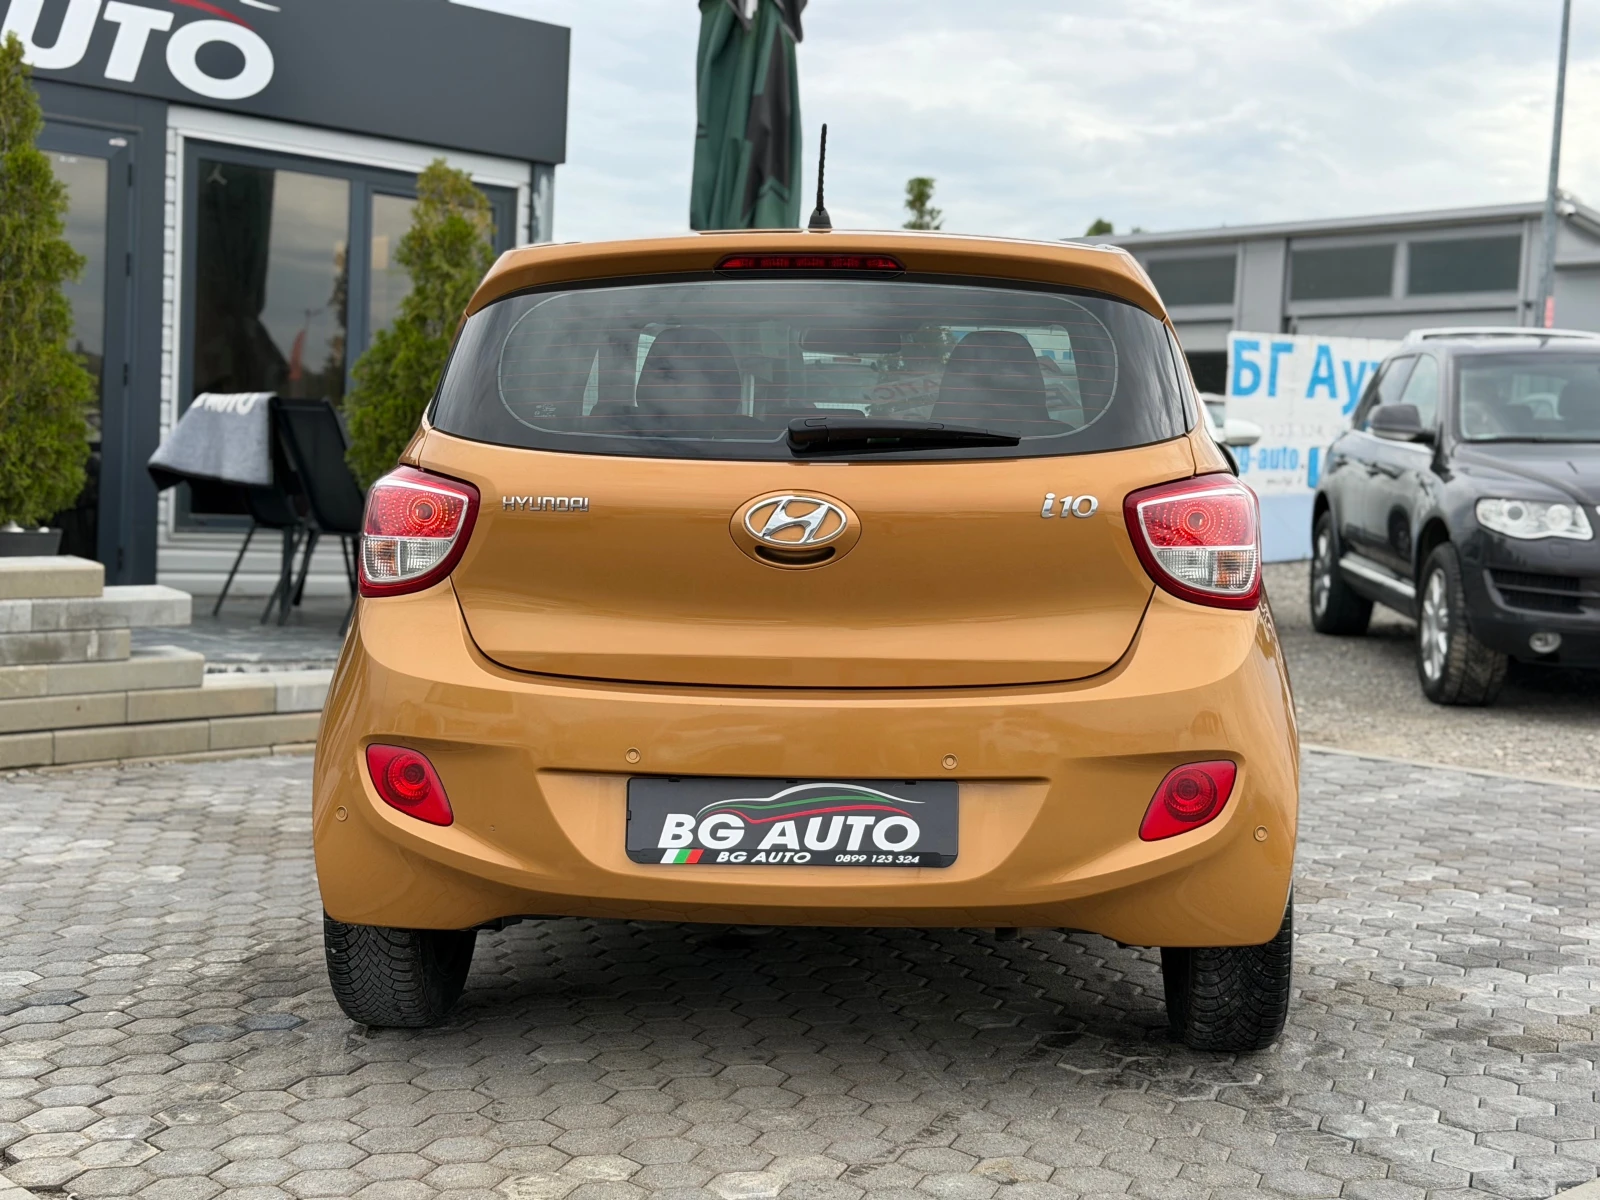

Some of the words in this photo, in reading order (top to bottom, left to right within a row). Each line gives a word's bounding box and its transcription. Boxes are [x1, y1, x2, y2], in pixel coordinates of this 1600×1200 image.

[0, 0, 275, 100] UTO
[1232, 339, 1294, 397] БГ
[502, 495, 590, 512] HYUNDAI
[1040, 492, 1099, 519] i10
[657, 813, 745, 850] BG
[757, 815, 921, 852] AUTO
[716, 851, 748, 863] BG
[751, 851, 812, 864] AUTO
[834, 853, 866, 864] 0899
[871, 854, 893, 864] 123
[895, 854, 920, 864] 324
